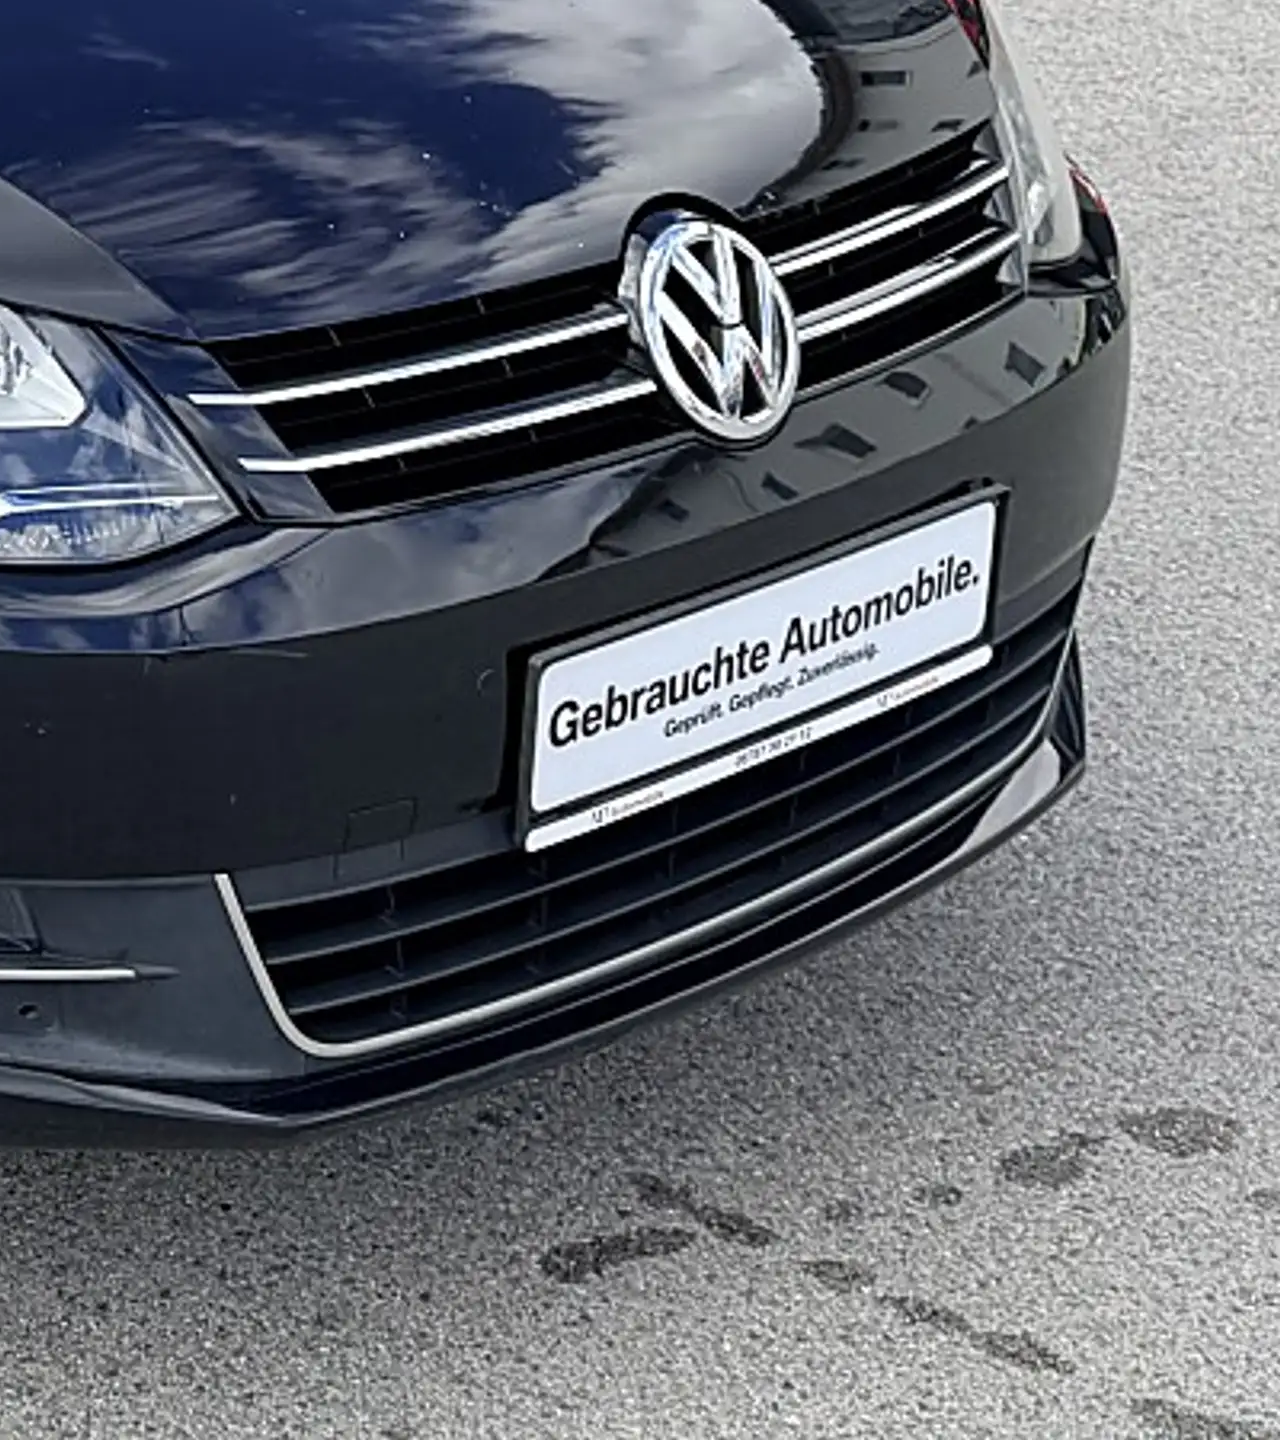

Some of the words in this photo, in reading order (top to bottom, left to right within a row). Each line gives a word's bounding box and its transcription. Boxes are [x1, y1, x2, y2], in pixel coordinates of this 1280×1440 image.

[549, 641, 770, 747] Gebrauchte
[778, 554, 980, 664] Automobile.
[663, 703, 724, 738] Geprüft.
[728, 676, 795, 713] Gepflegt.
